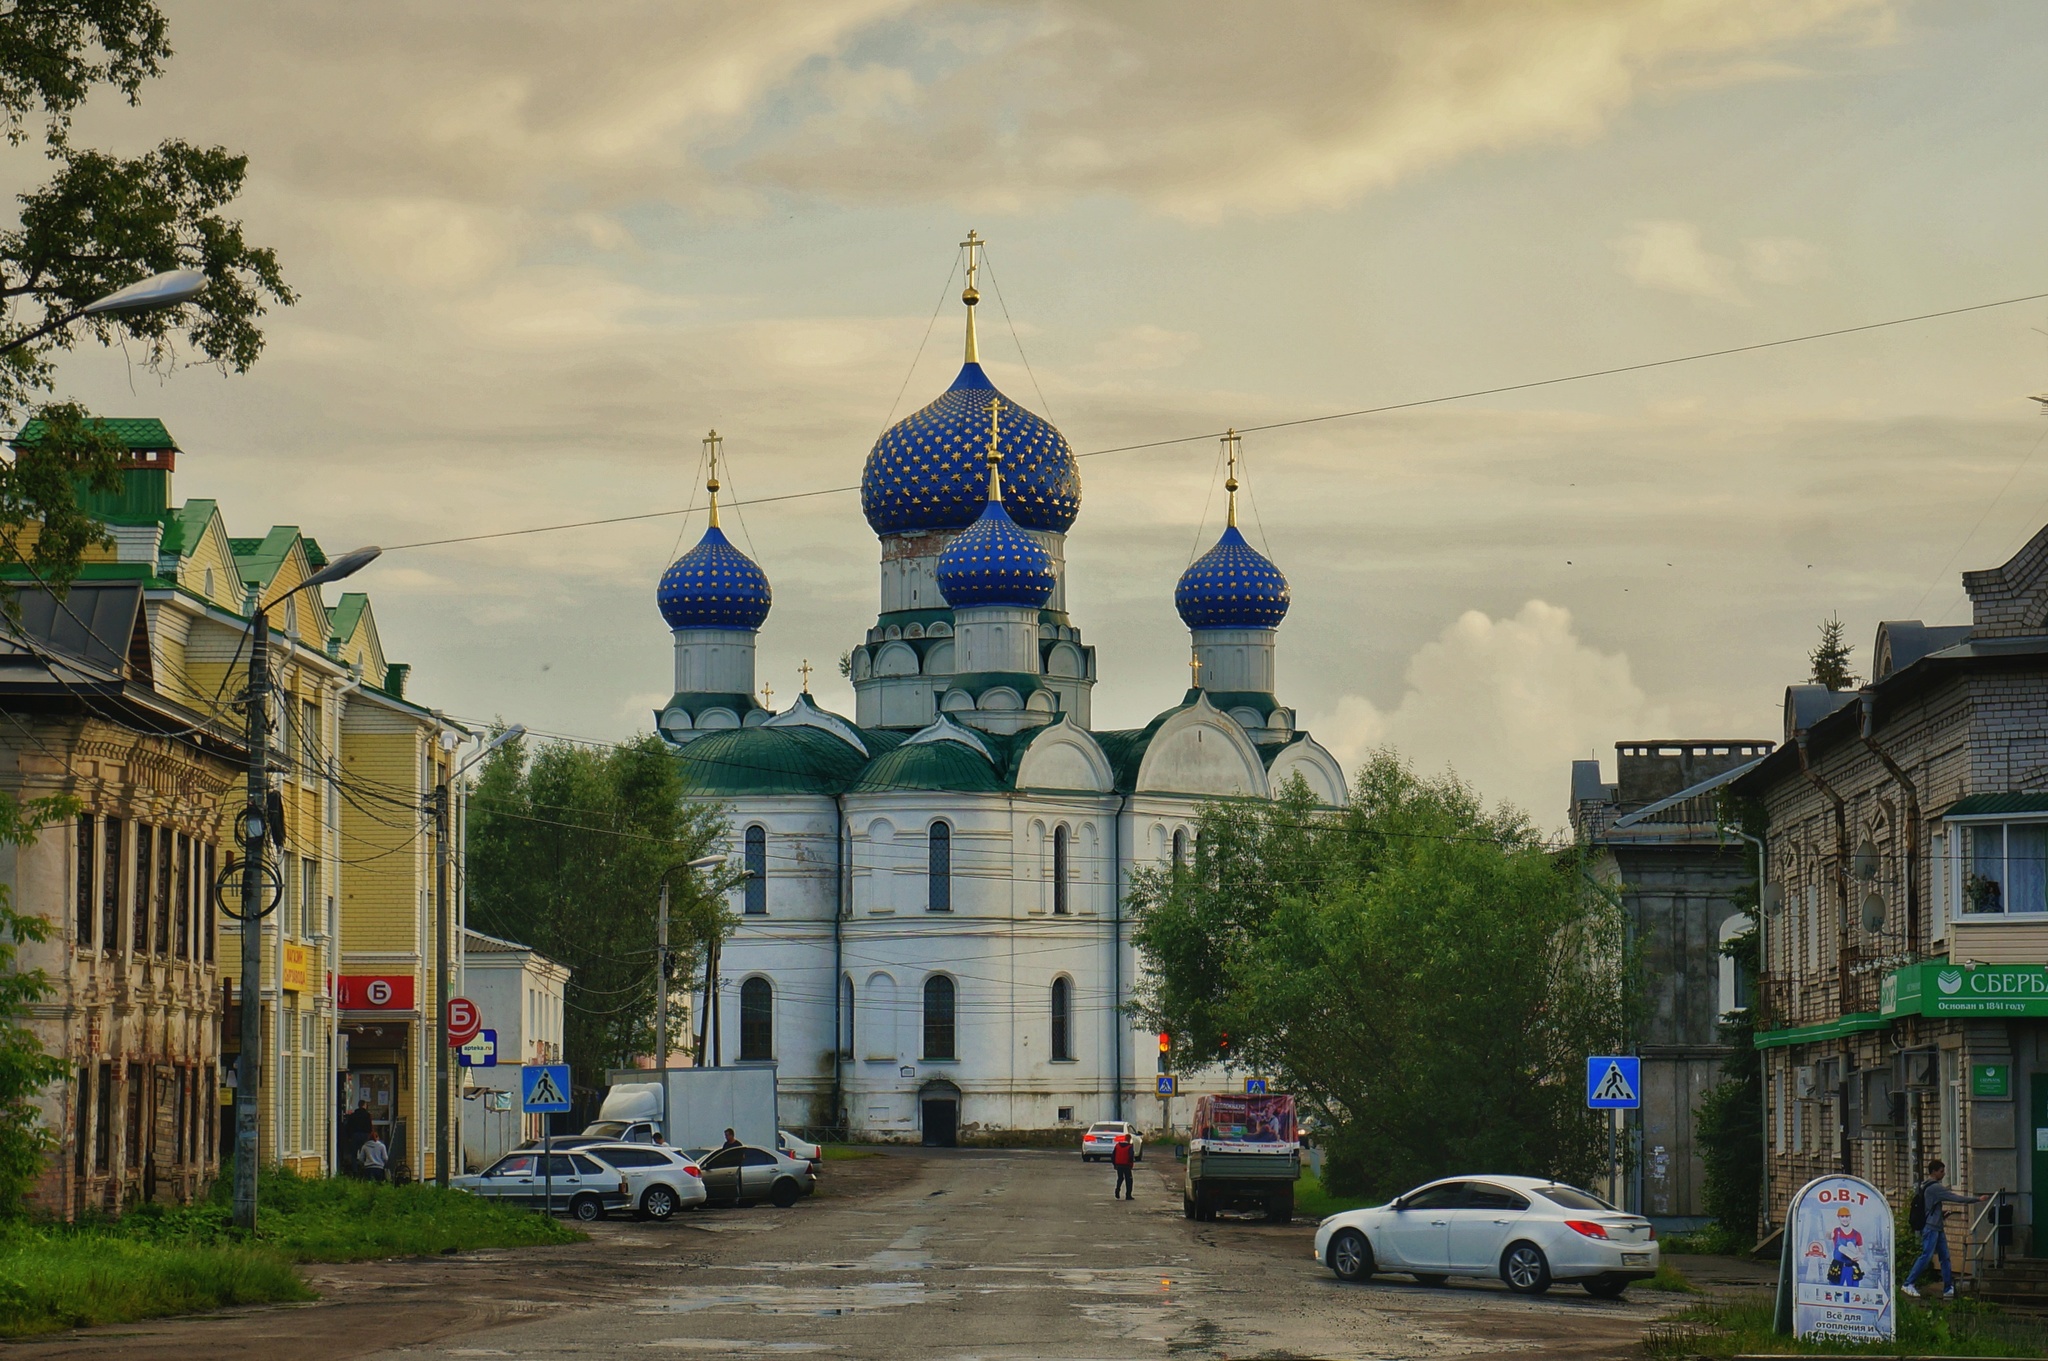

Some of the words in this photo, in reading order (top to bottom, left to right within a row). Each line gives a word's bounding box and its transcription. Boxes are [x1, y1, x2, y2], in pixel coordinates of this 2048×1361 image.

[1970, 973, 2048, 993] СБЕРБ
[373, 984, 387, 1000] Б
[1938, 1002, 1977, 1010] Основан
[1986, 1002, 2003, 1010] 1841
[2005, 1003, 2026, 1011] году
[451, 1003, 471, 1025] Б
[1826, 1310, 1842, 1320] Всё
[1843, 1313, 1862, 1322] для
[1815, 1322, 1866, 1332] отопления
